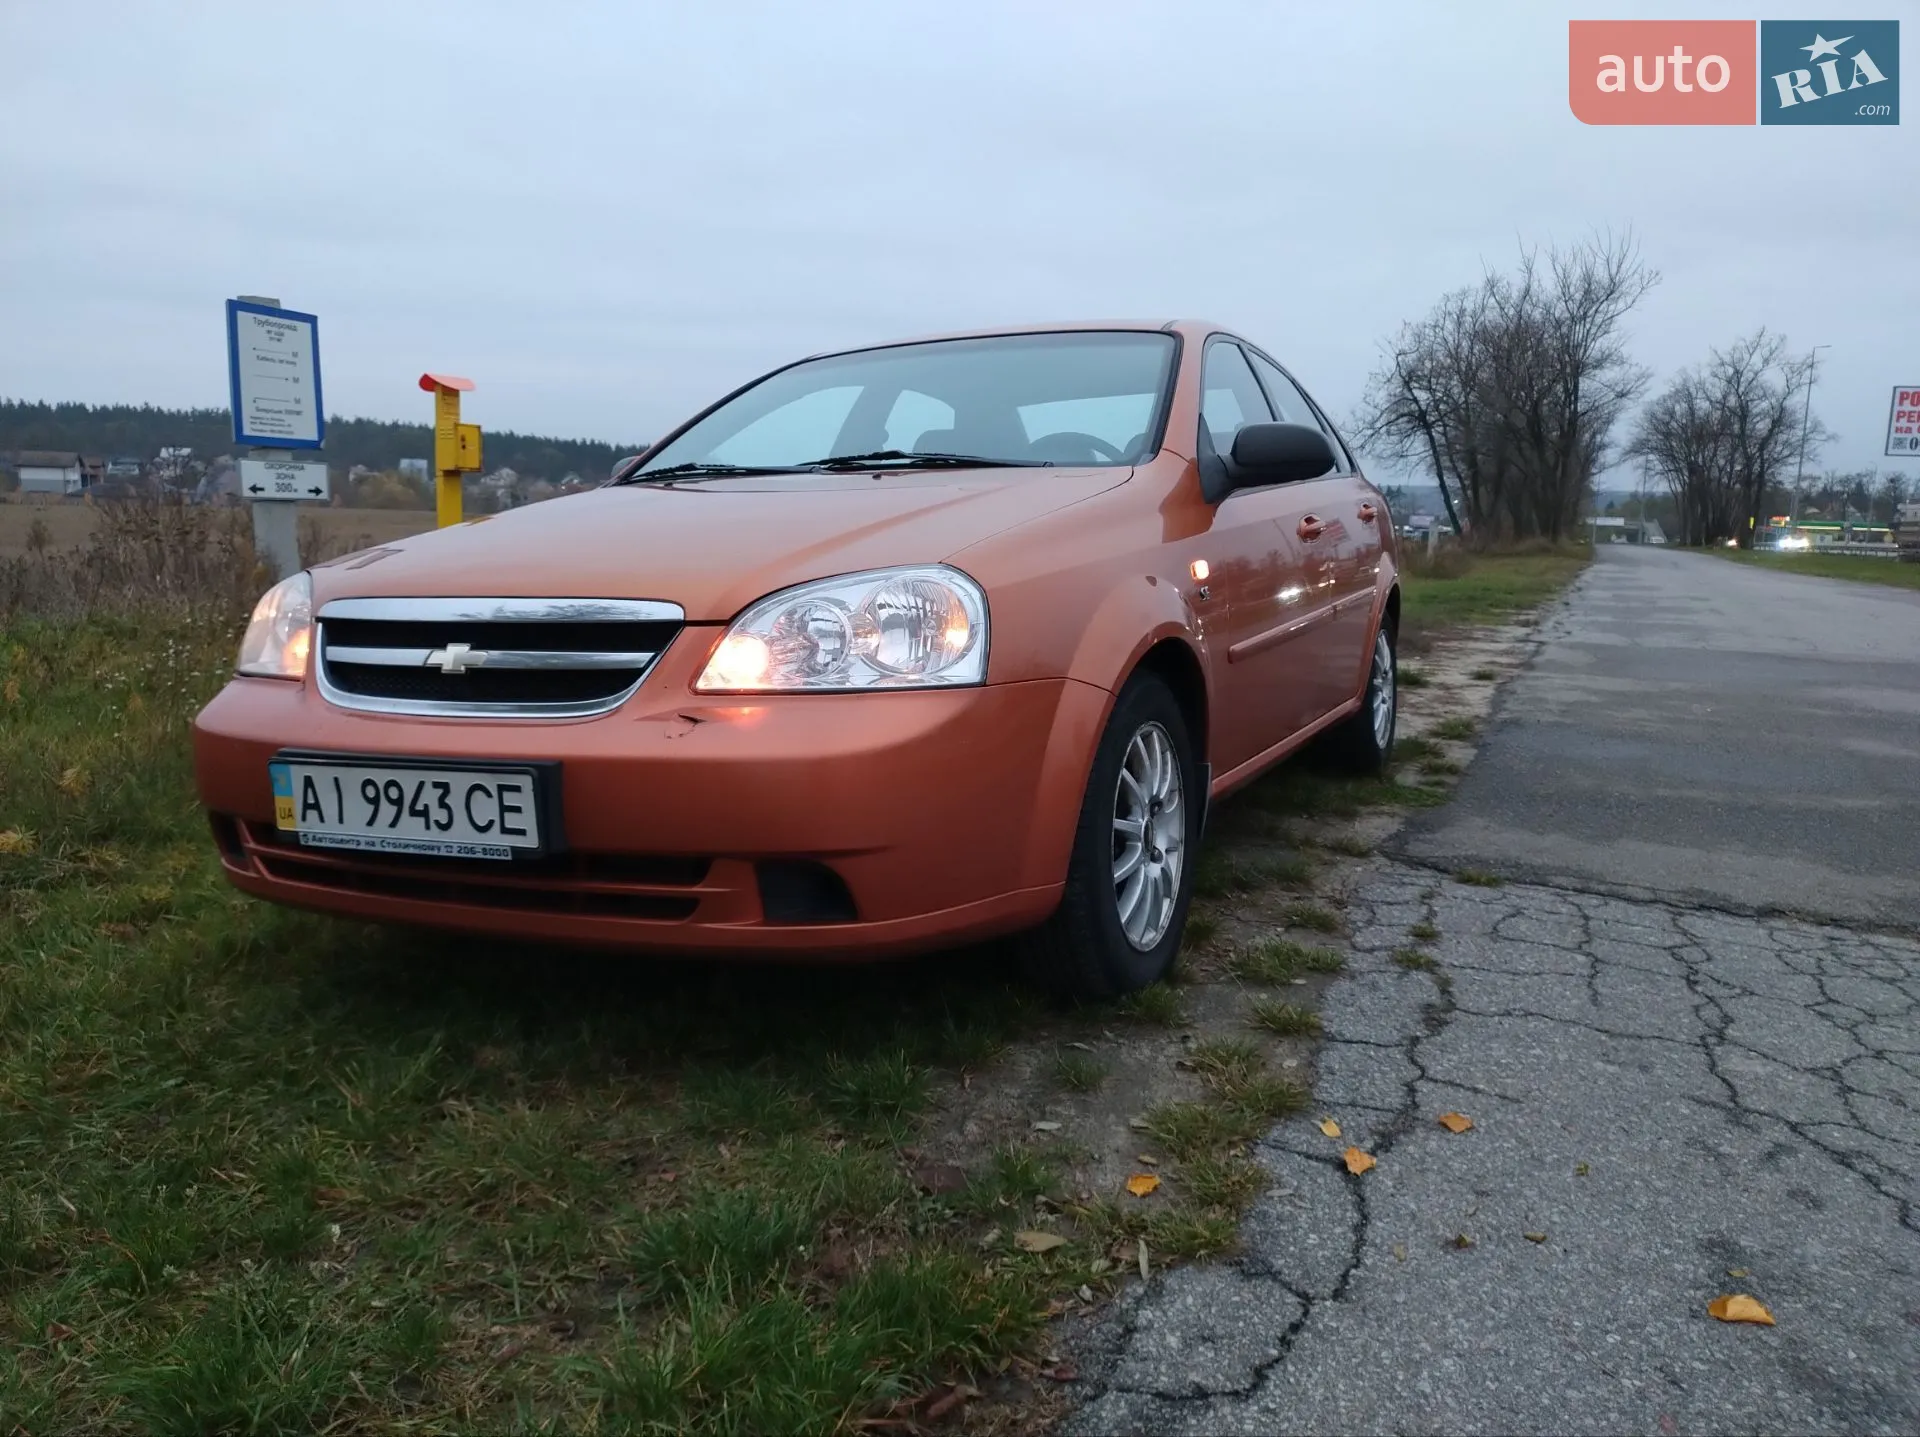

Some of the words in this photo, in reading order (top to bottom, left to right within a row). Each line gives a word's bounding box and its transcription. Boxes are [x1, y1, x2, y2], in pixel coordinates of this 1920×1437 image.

[279, 807, 294, 820] UA
[301, 774, 344, 825] AI
[360, 777, 455, 833] 9943
[464, 782, 528, 837] CE
[364, 840, 377, 848] на
[456, 845, 510, 858] 206-8000
